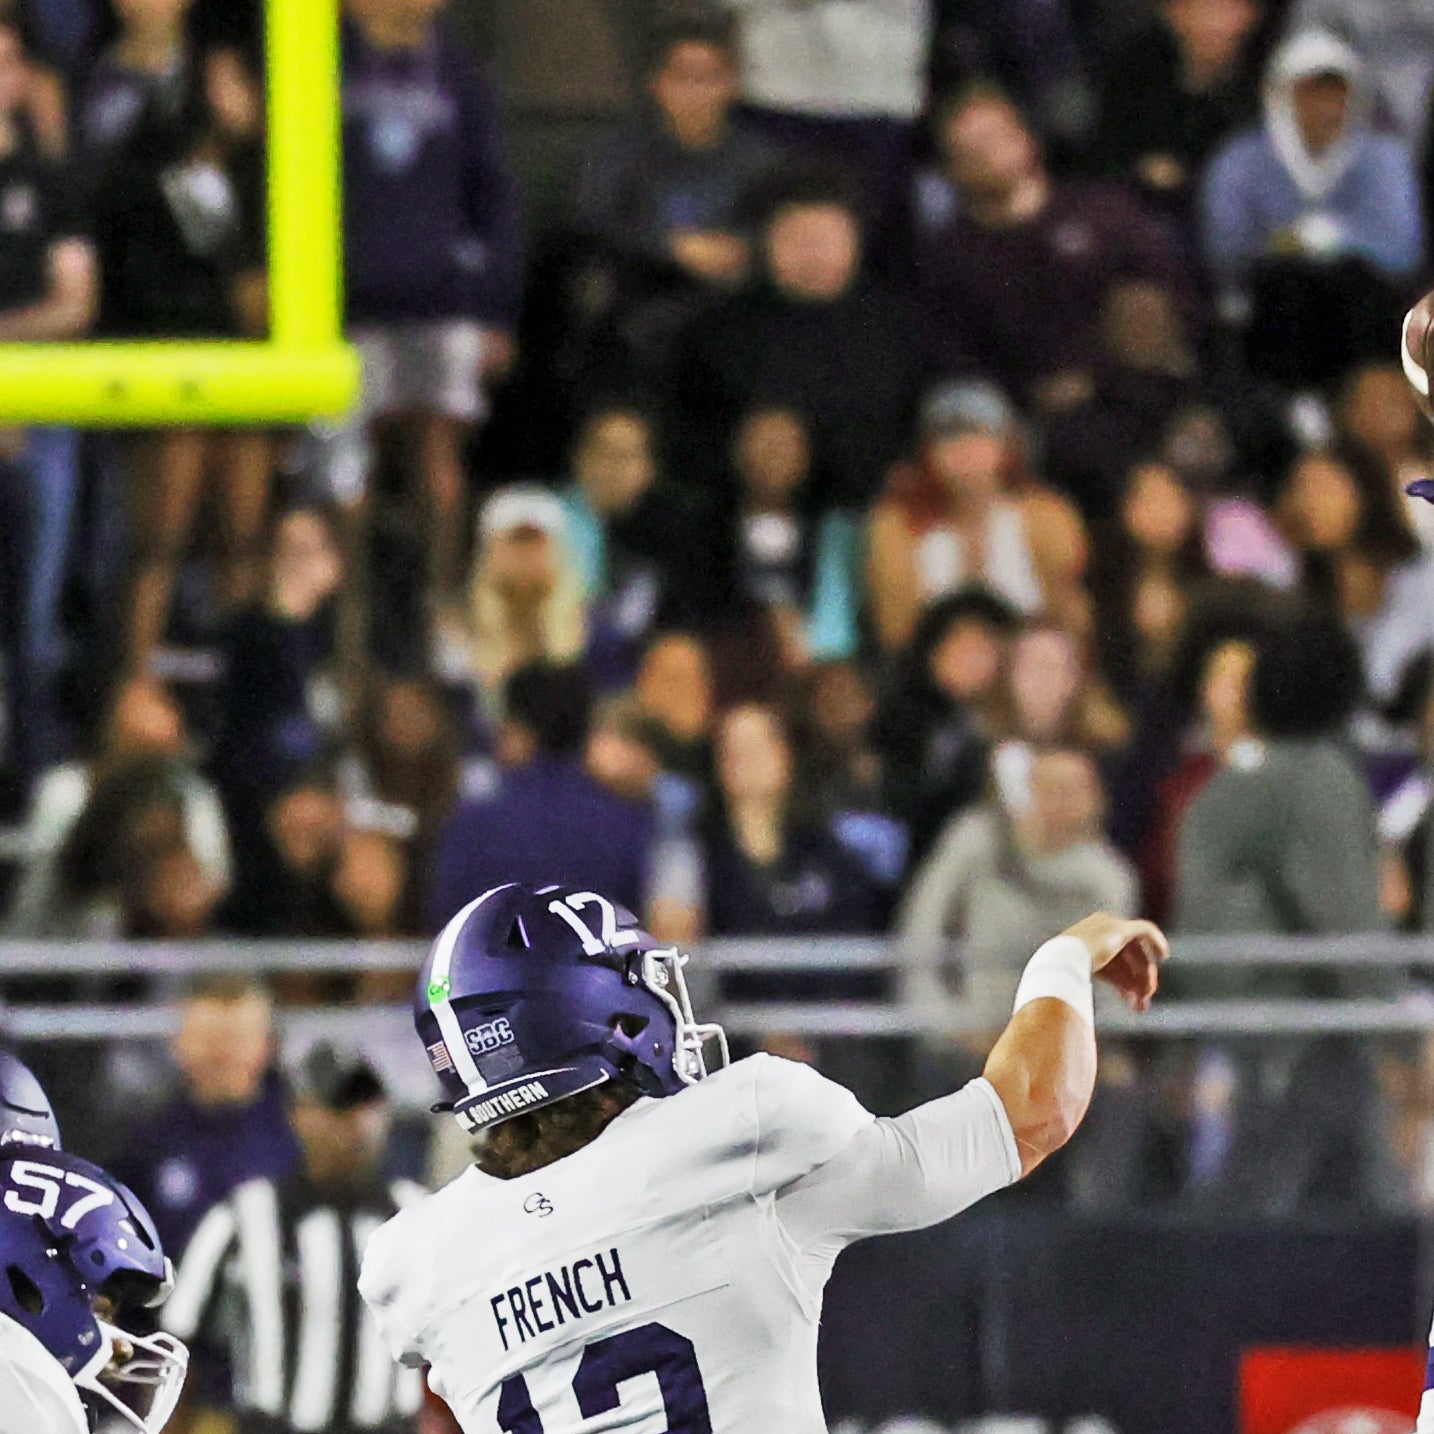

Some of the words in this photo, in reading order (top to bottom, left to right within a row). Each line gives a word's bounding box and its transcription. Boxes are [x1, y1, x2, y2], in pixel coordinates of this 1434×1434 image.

[548, 891, 640, 956] 12
[464, 1017, 515, 1055] SBC
[469, 1081, 549, 1125] SOUTHERN
[4, 1160, 114, 1229] 57
[490, 1248, 631, 1351] FRENCH
